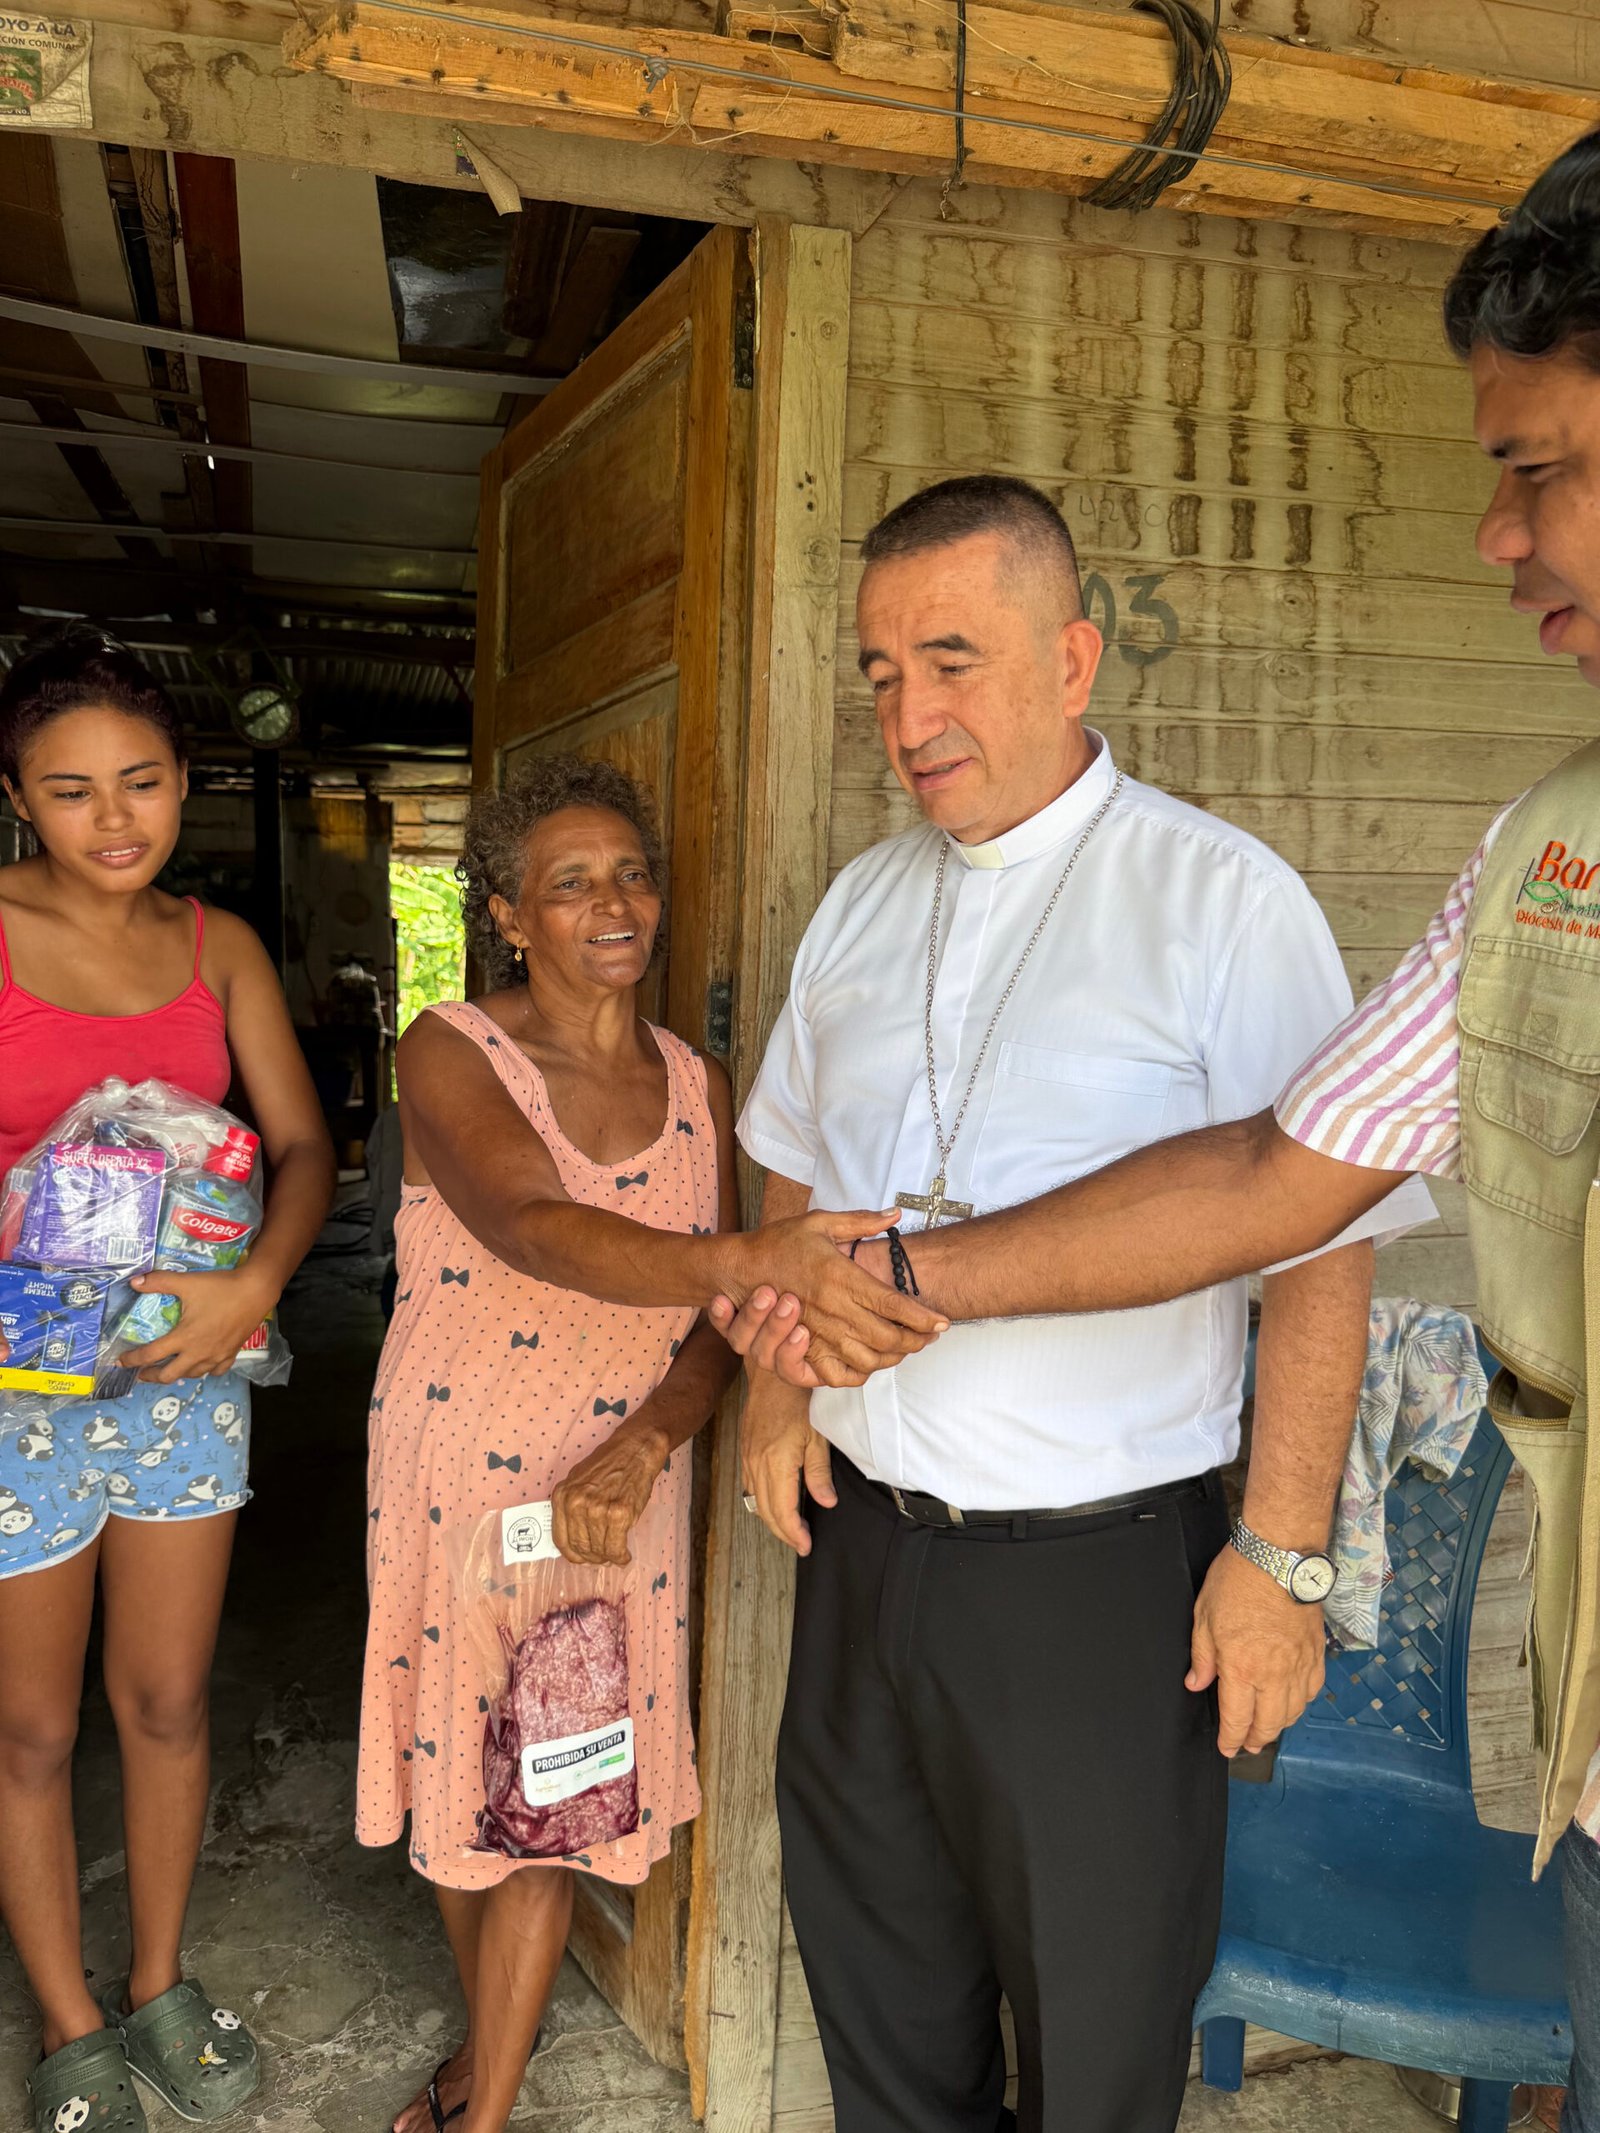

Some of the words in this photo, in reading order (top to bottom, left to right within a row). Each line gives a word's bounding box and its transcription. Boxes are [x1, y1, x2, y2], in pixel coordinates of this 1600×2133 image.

[36, 22, 48, 34] A
[54, 23, 76, 37] LA
[29, 39, 77, 51] COMUNAL
[1566, 919, 1582, 934] de
[62, 1151, 96, 1165] SUPER
[98, 1154, 134, 1169] OFERTA
[178, 1212, 239, 1237] Colgate
[170, 1235, 216, 1257] PLAX
[23, 1287, 57, 1297] XTREME
[27, 1281, 54, 1290] NIGHT
[535, 1750, 585, 1772] PROHIBIDA
[586, 1744, 597, 1756] SU
[598, 1733, 622, 1751] VENTA
